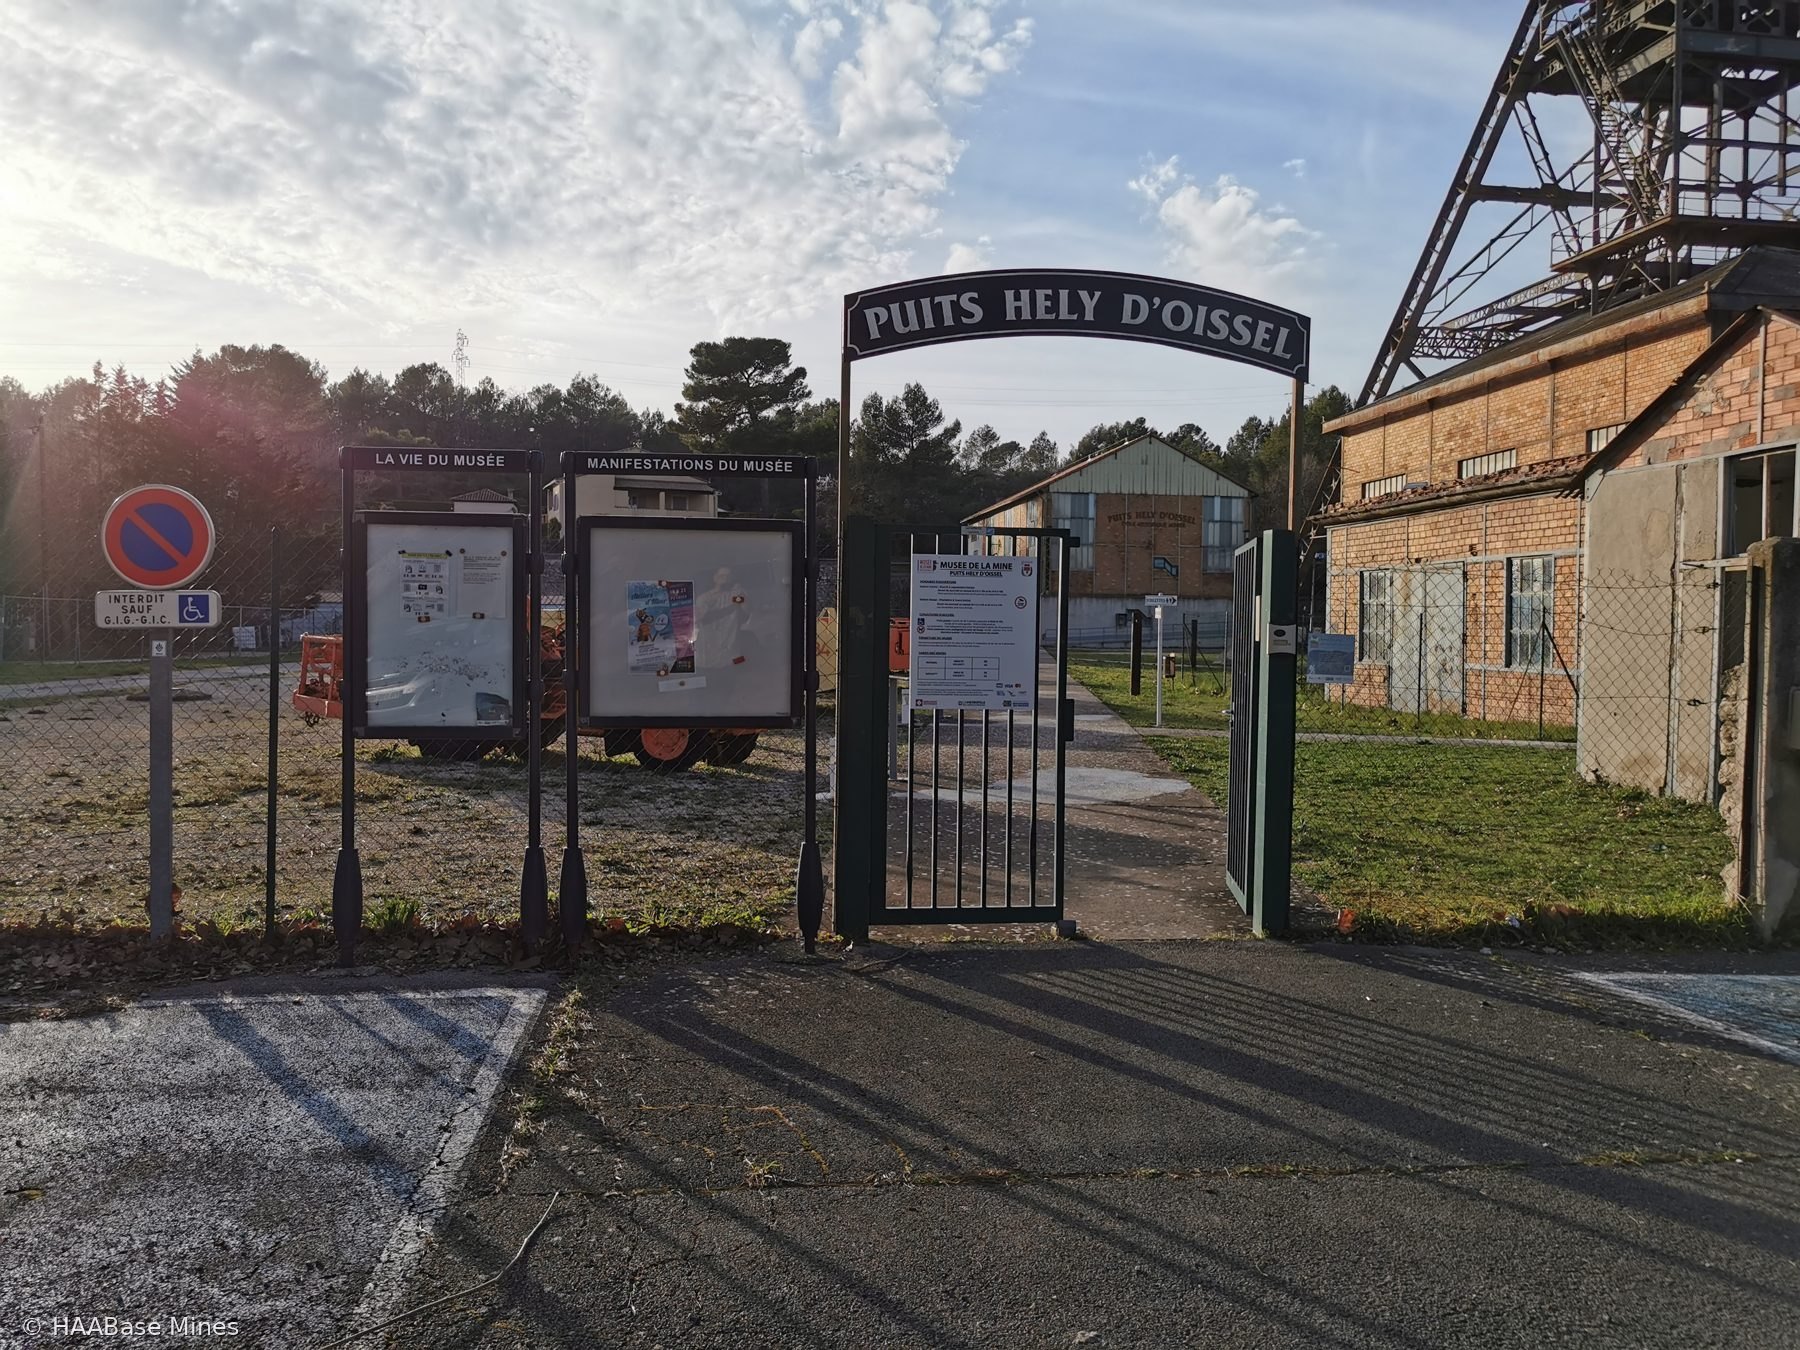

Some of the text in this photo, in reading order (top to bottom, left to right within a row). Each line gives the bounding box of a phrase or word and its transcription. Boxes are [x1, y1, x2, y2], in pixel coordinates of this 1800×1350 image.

[862, 288, 1293, 360] PUITS HELY D'OISSEL
[375, 451, 506, 468] LA VIE DU MUSÉE
[587, 455, 794, 473] MANIFESTATIONS DU MUSÉE
[1107, 512, 1132, 523] PUITS
[1135, 511, 1155, 519] HELY
[940, 561, 967, 570] MUSEE
[968, 562, 980, 570] DE
[981, 562, 991, 570] LA
[992, 562, 1013, 570] MINE
[108, 594, 165, 604] INTERDIT
[121, 605, 153, 614] SAUF
